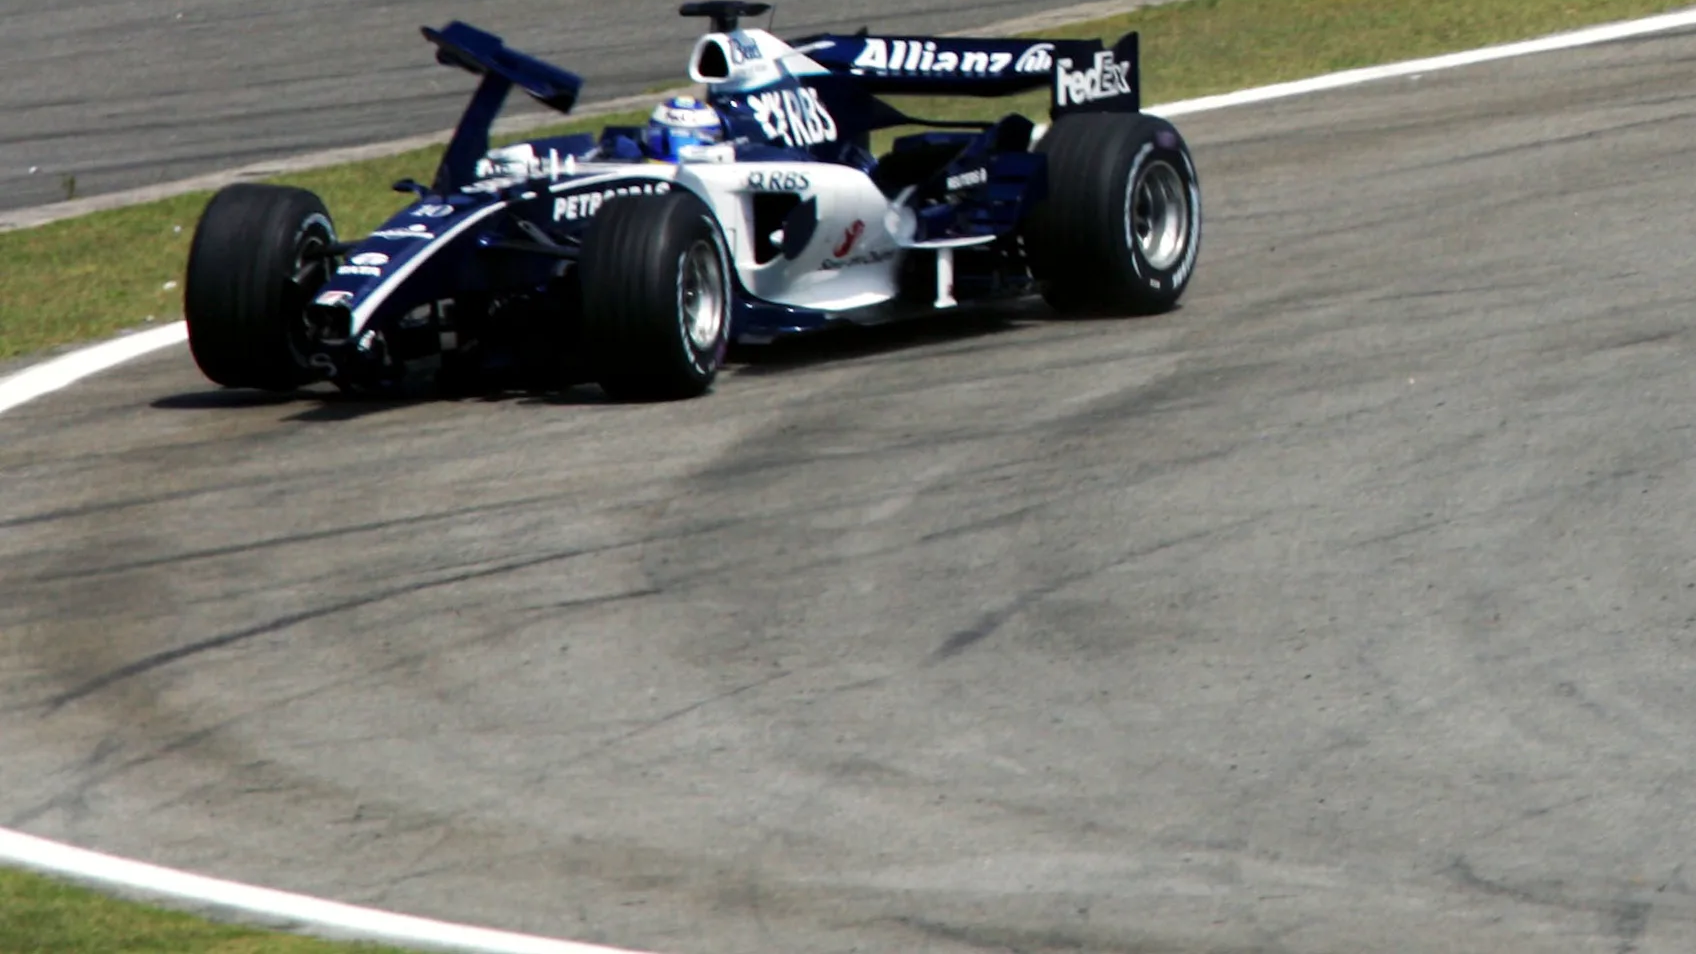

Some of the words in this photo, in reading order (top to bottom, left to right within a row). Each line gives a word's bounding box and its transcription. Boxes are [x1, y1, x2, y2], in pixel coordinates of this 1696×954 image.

[853, 38, 1013, 74] Allianz
[1056, 51, 1131, 106] FedEx
[783, 87, 838, 147] RBS
[769, 170, 811, 191] RBS
